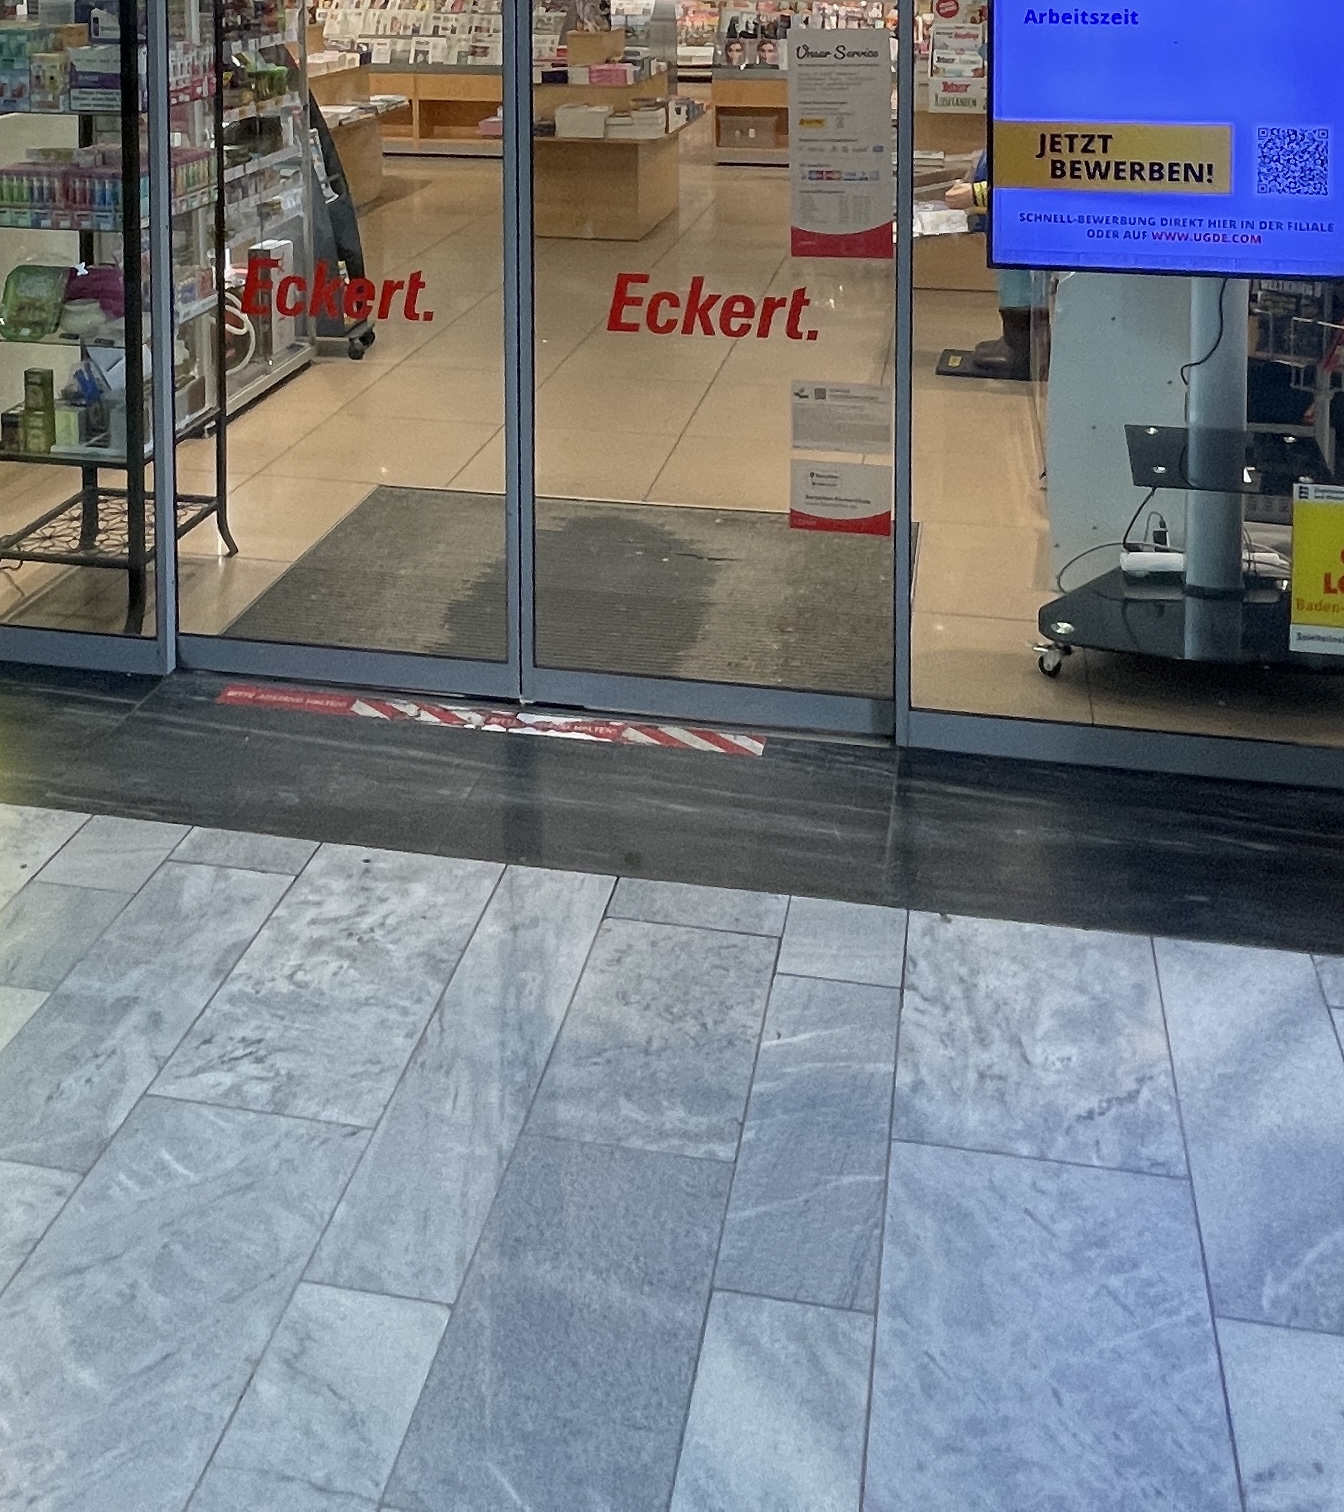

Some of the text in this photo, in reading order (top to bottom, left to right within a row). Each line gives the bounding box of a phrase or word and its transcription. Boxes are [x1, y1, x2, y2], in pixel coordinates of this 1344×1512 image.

[1024, 8, 1139, 26] Arbeitszeit
[834, 45, 879, 60] Service
[1036, 132, 1113, 159] JETZT
[1050, 158, 1214, 184] BEWERBEN!
[1019, 212, 1335, 234] SCHNELL-BEWERBUNG DIREKT HIER IN DER FILIALE
[1087, 228, 1262, 245] ODER AUF WWW.UGDE.COM
[241, 258, 435, 322] Eckert.
[606, 272, 820, 342] Eckert.
